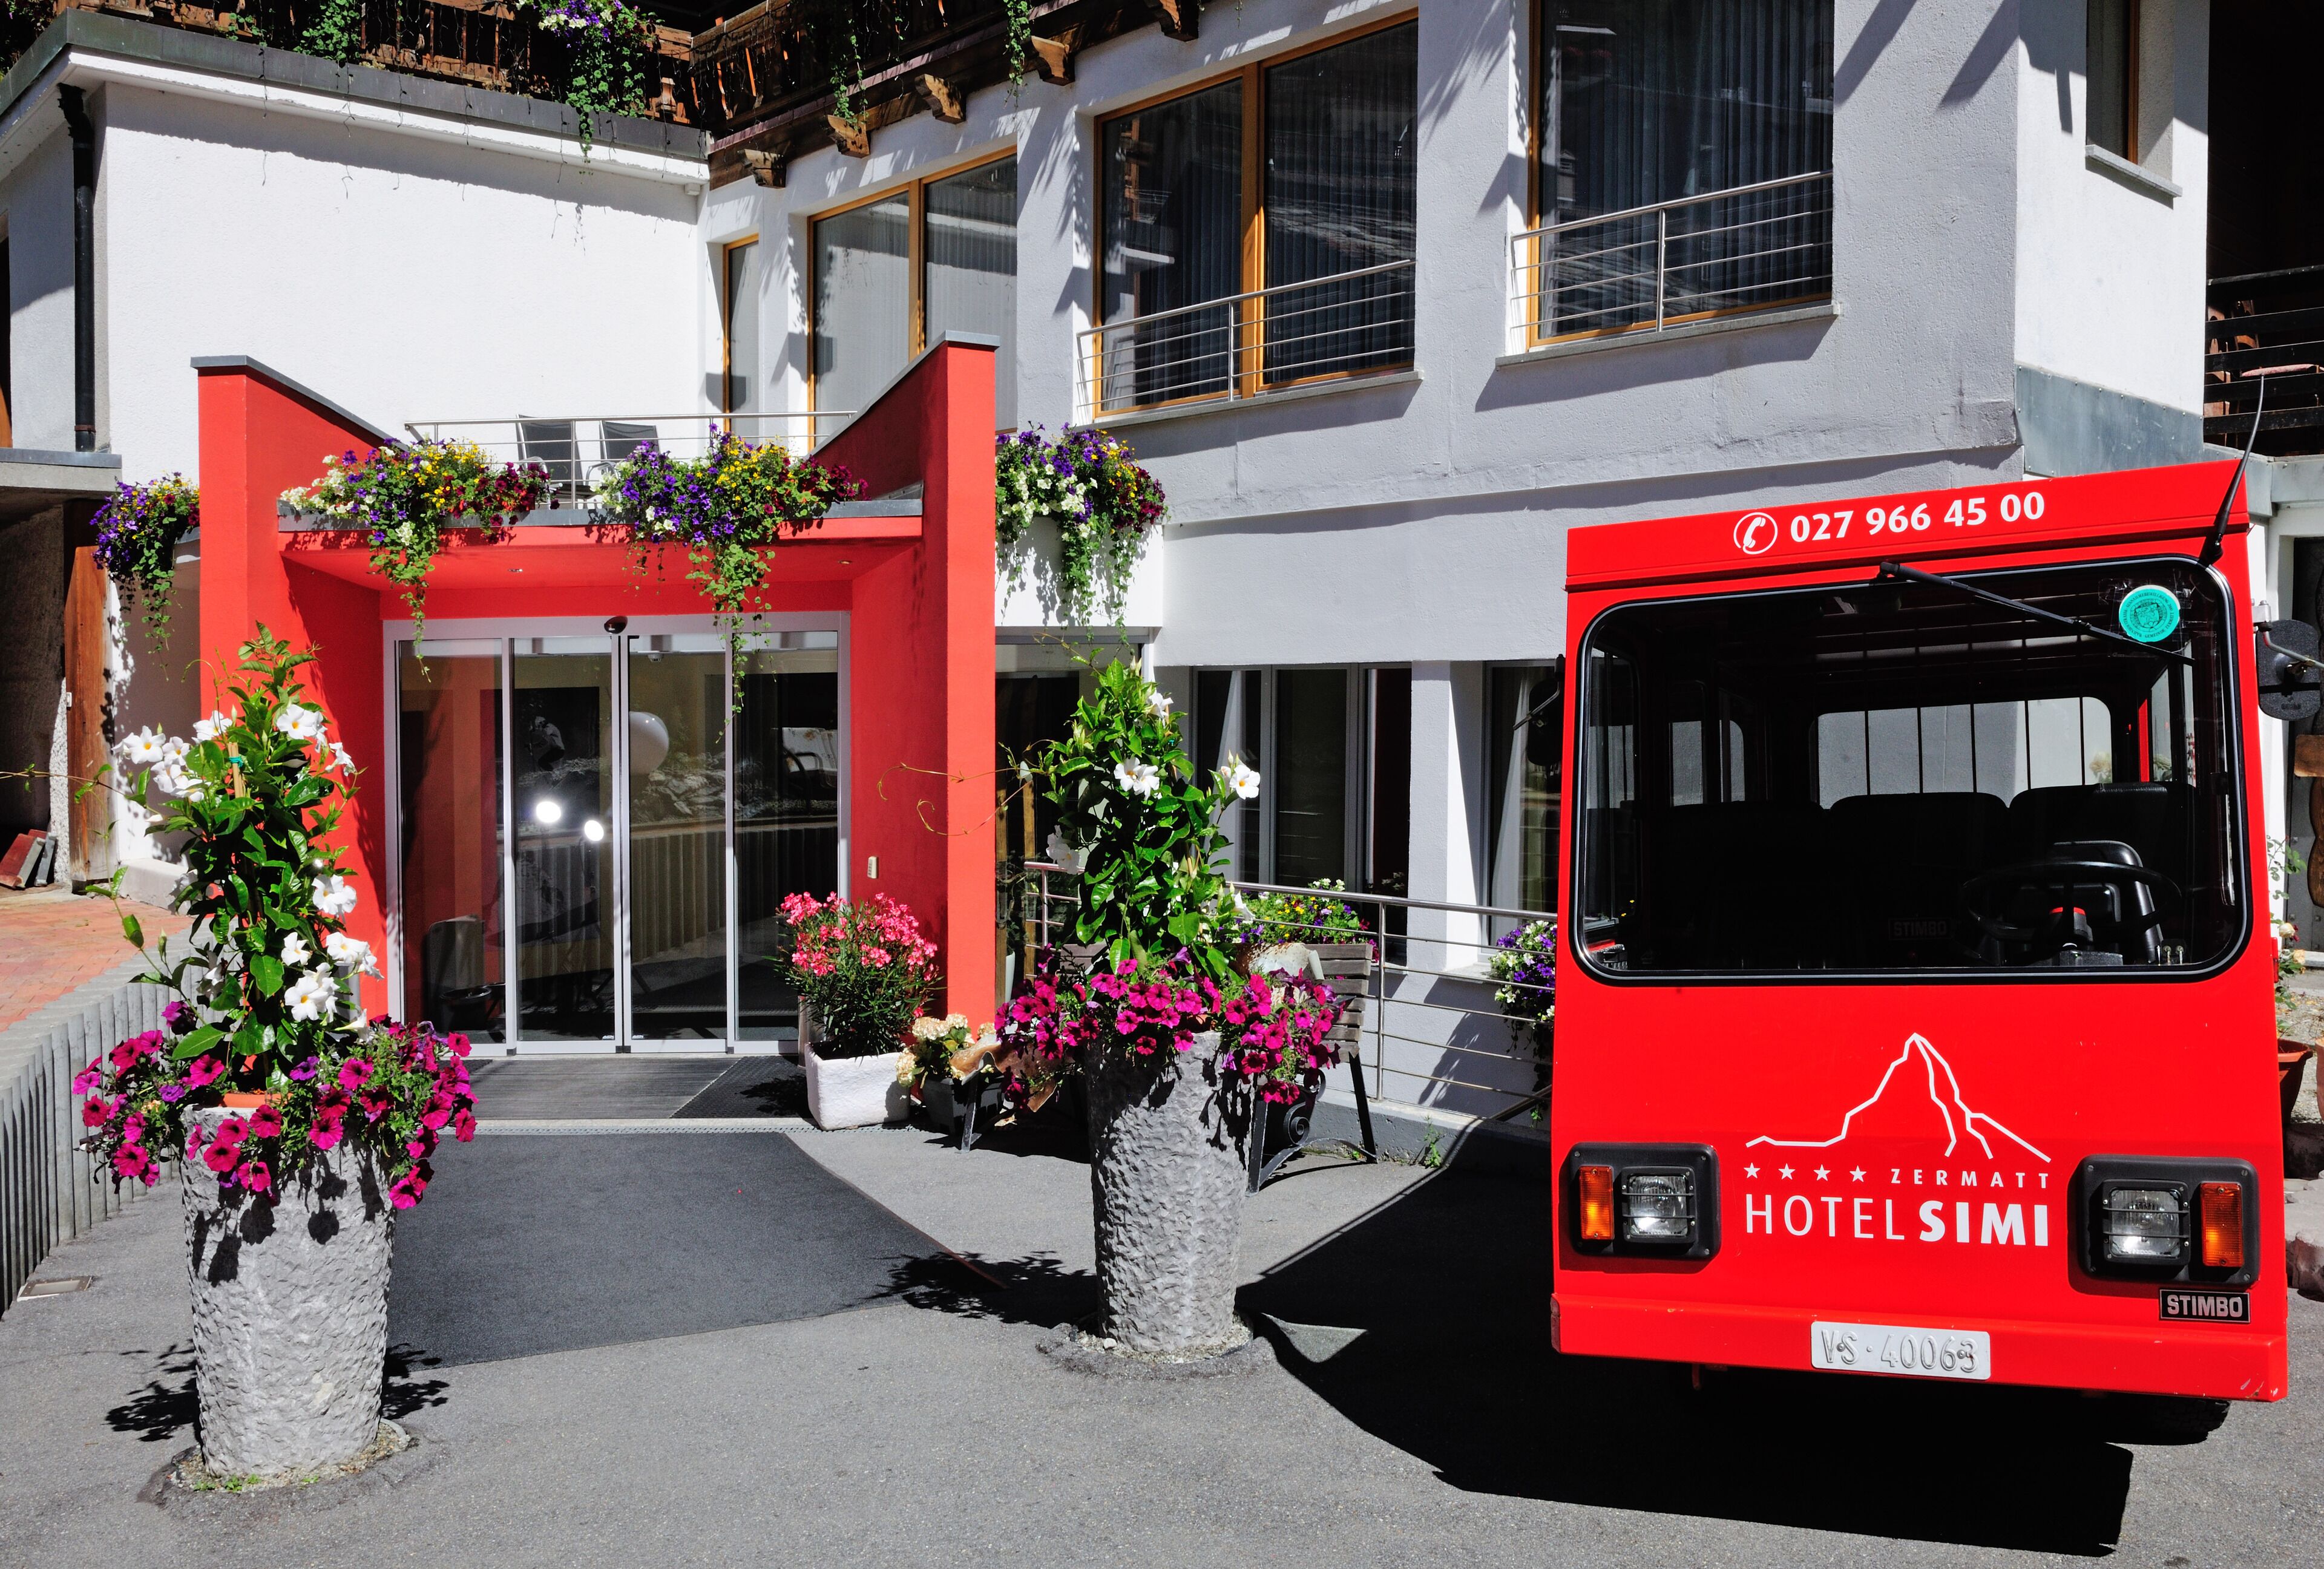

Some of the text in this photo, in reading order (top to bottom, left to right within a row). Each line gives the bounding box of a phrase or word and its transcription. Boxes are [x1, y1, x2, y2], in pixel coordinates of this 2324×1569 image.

[1790, 491, 2044, 543] 027 966 45 00
[1893, 920, 1947, 937] STIMBO
[1891, 1168, 2049, 1188] ZERMATT
[1746, 1194, 2048, 1246] HOTEL SIMI
[2167, 1295, 2243, 1317] STIMBO
